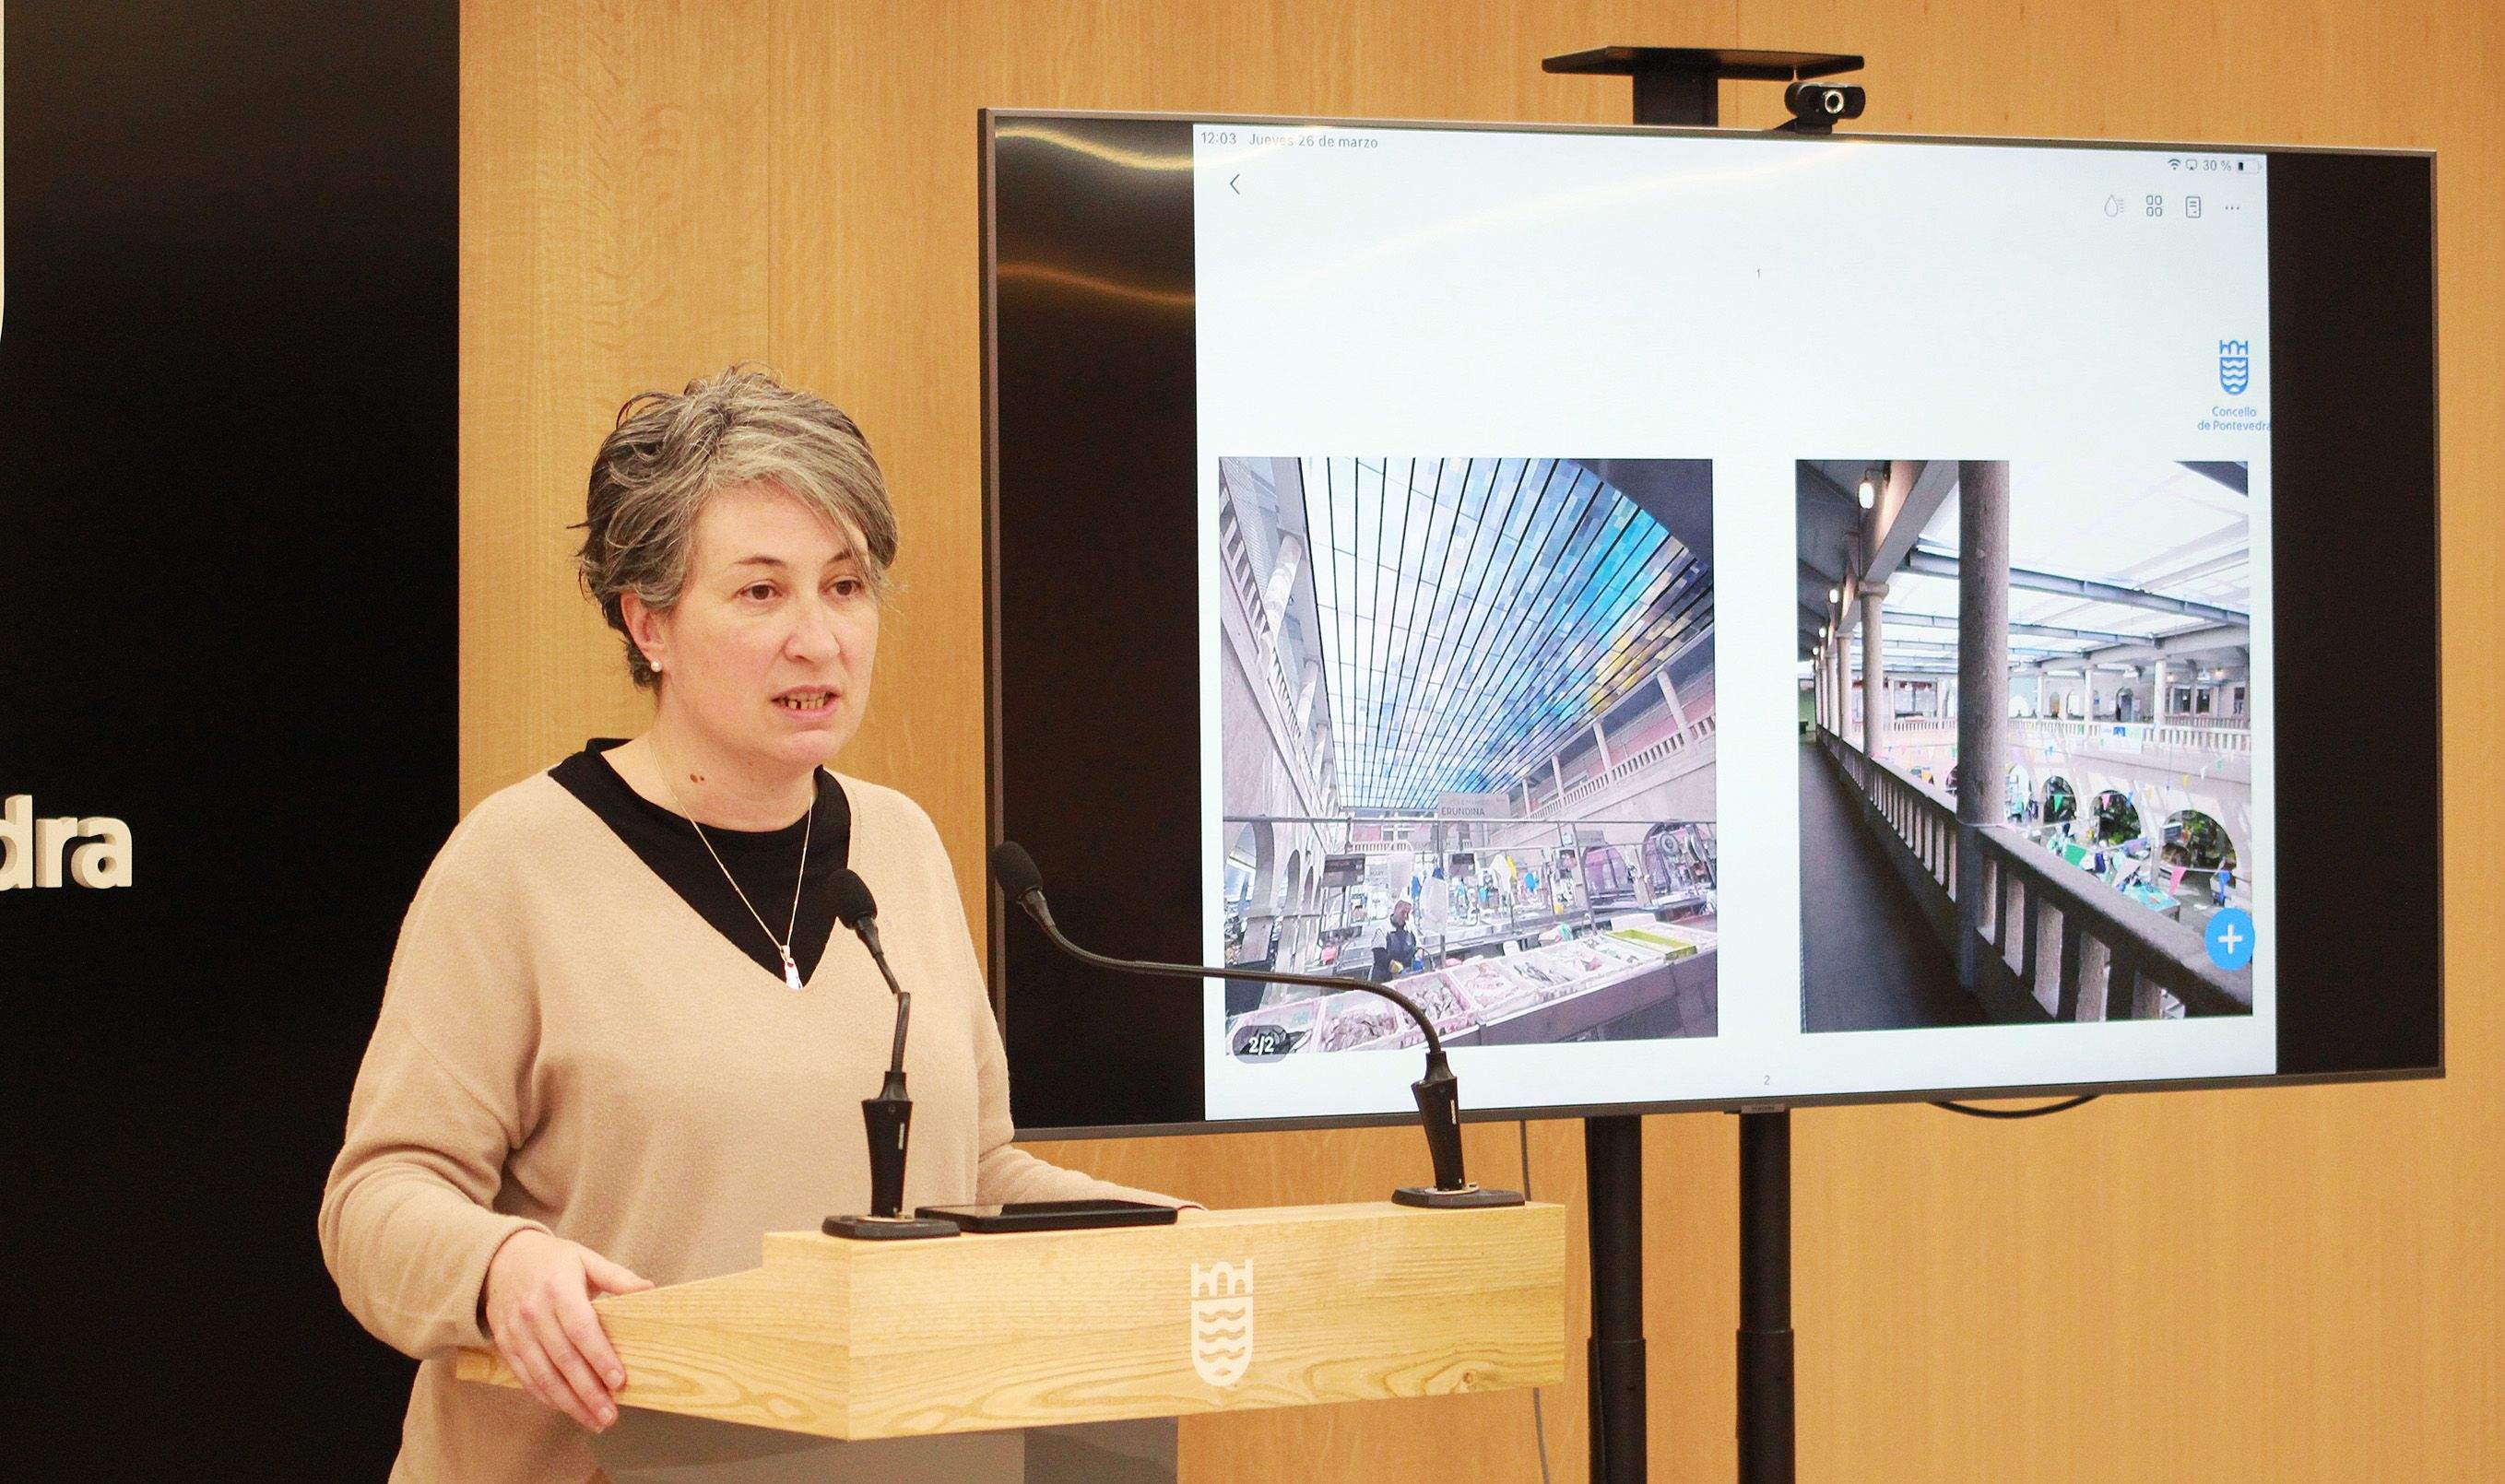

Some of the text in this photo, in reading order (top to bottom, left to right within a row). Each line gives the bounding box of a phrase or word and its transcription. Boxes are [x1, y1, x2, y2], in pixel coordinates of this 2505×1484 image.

[1200, 132, 1378, 148] 12:03 Jueves 26 de marzo
[2203, 160, 2217, 171] 30
[2212, 406, 2257, 418] Concello
[2197, 420, 2211, 431] de
[1248, 1035, 1274, 1056] 2/2
[1763, 1075, 1770, 1086] 2
